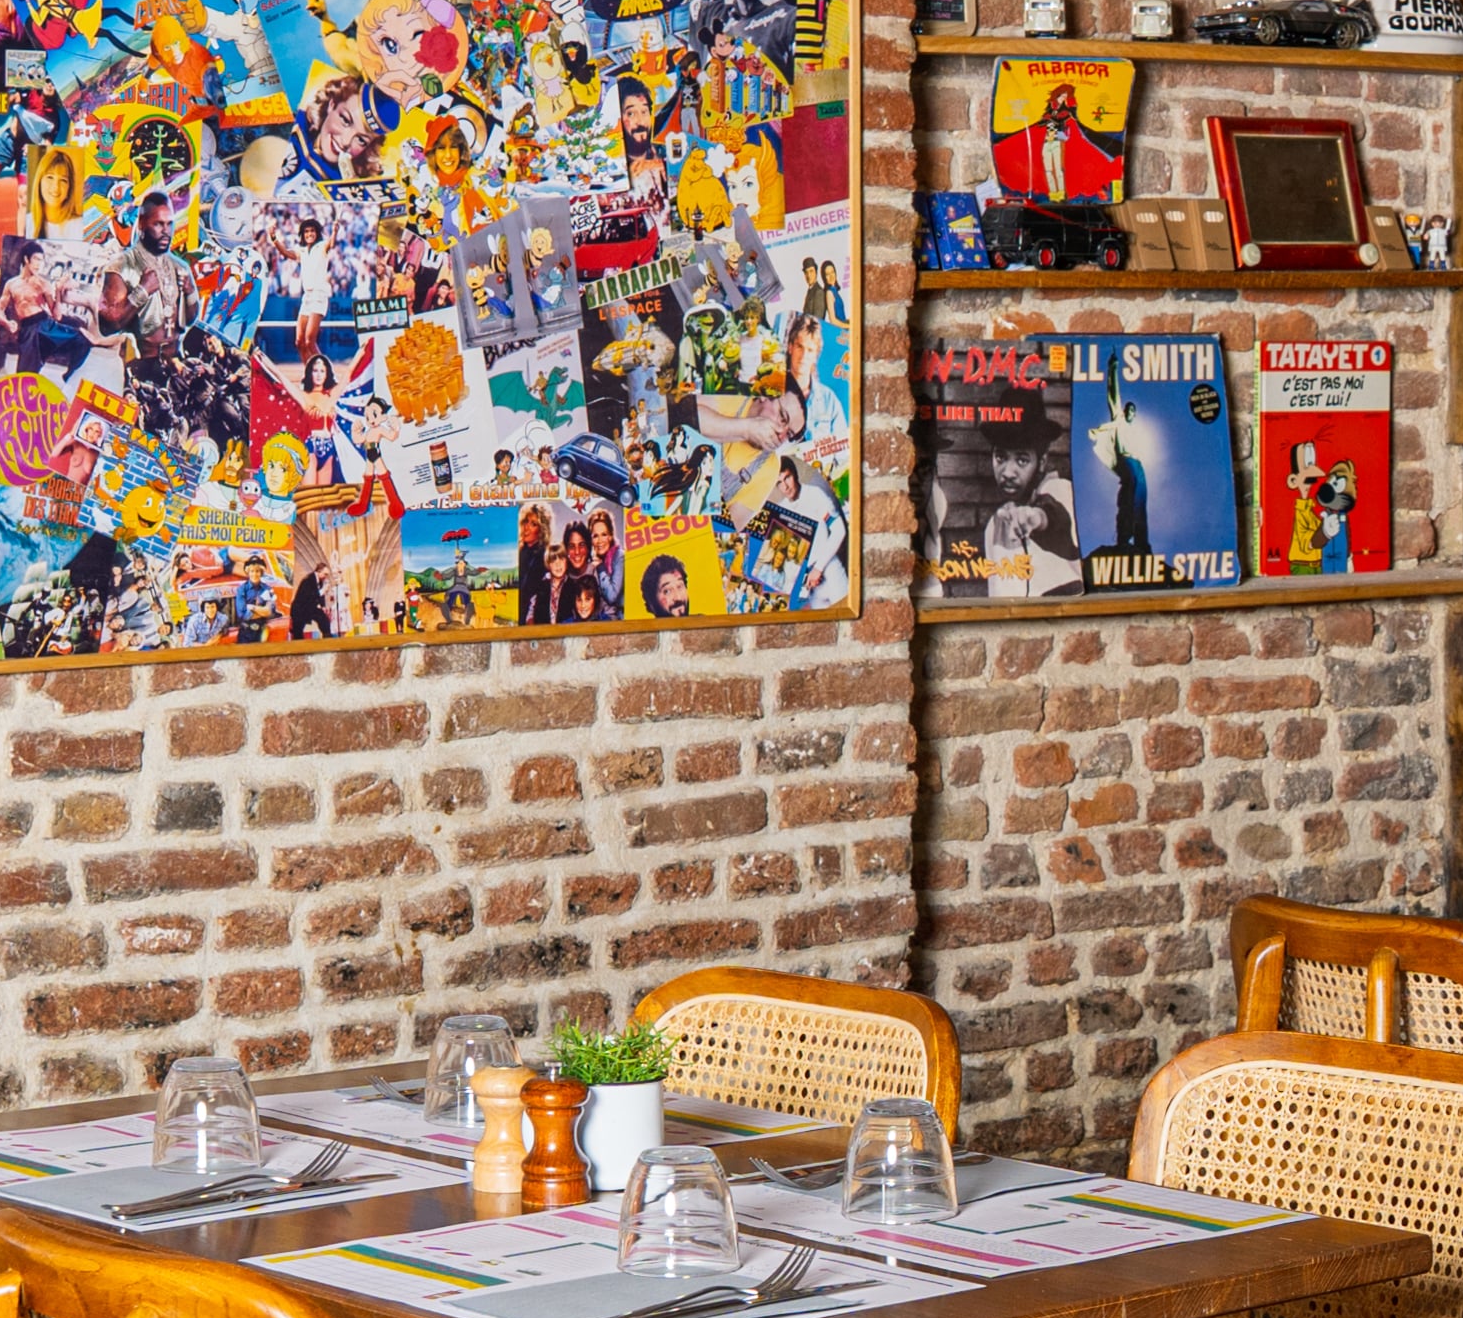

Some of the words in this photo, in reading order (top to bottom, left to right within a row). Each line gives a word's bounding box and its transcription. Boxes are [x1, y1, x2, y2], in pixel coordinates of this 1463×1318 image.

[1028, 61, 1109, 79] ALBATOR
[788, 209, 851, 233] AVENGERS
[586, 257, 683, 309] BARBAPAPA
[356, 297, 406, 314] MIAMI
[599, 301, 663, 321] L'ESPACE
[1123, 344, 1214, 382] SMITH
[1266, 343, 1369, 370] TATAYET
[1283, 375, 1317, 392] C'EST
[1320, 376, 1341, 390] PAS
[1290, 393, 1322, 407] C'EST
[937, 405, 975, 421] LIKE
[978, 407, 1024, 422] THAT
[236, 528, 266, 543] PEUR
[1091, 554, 1167, 585] WILLIE
[1172, 551, 1235, 582] STYLE
